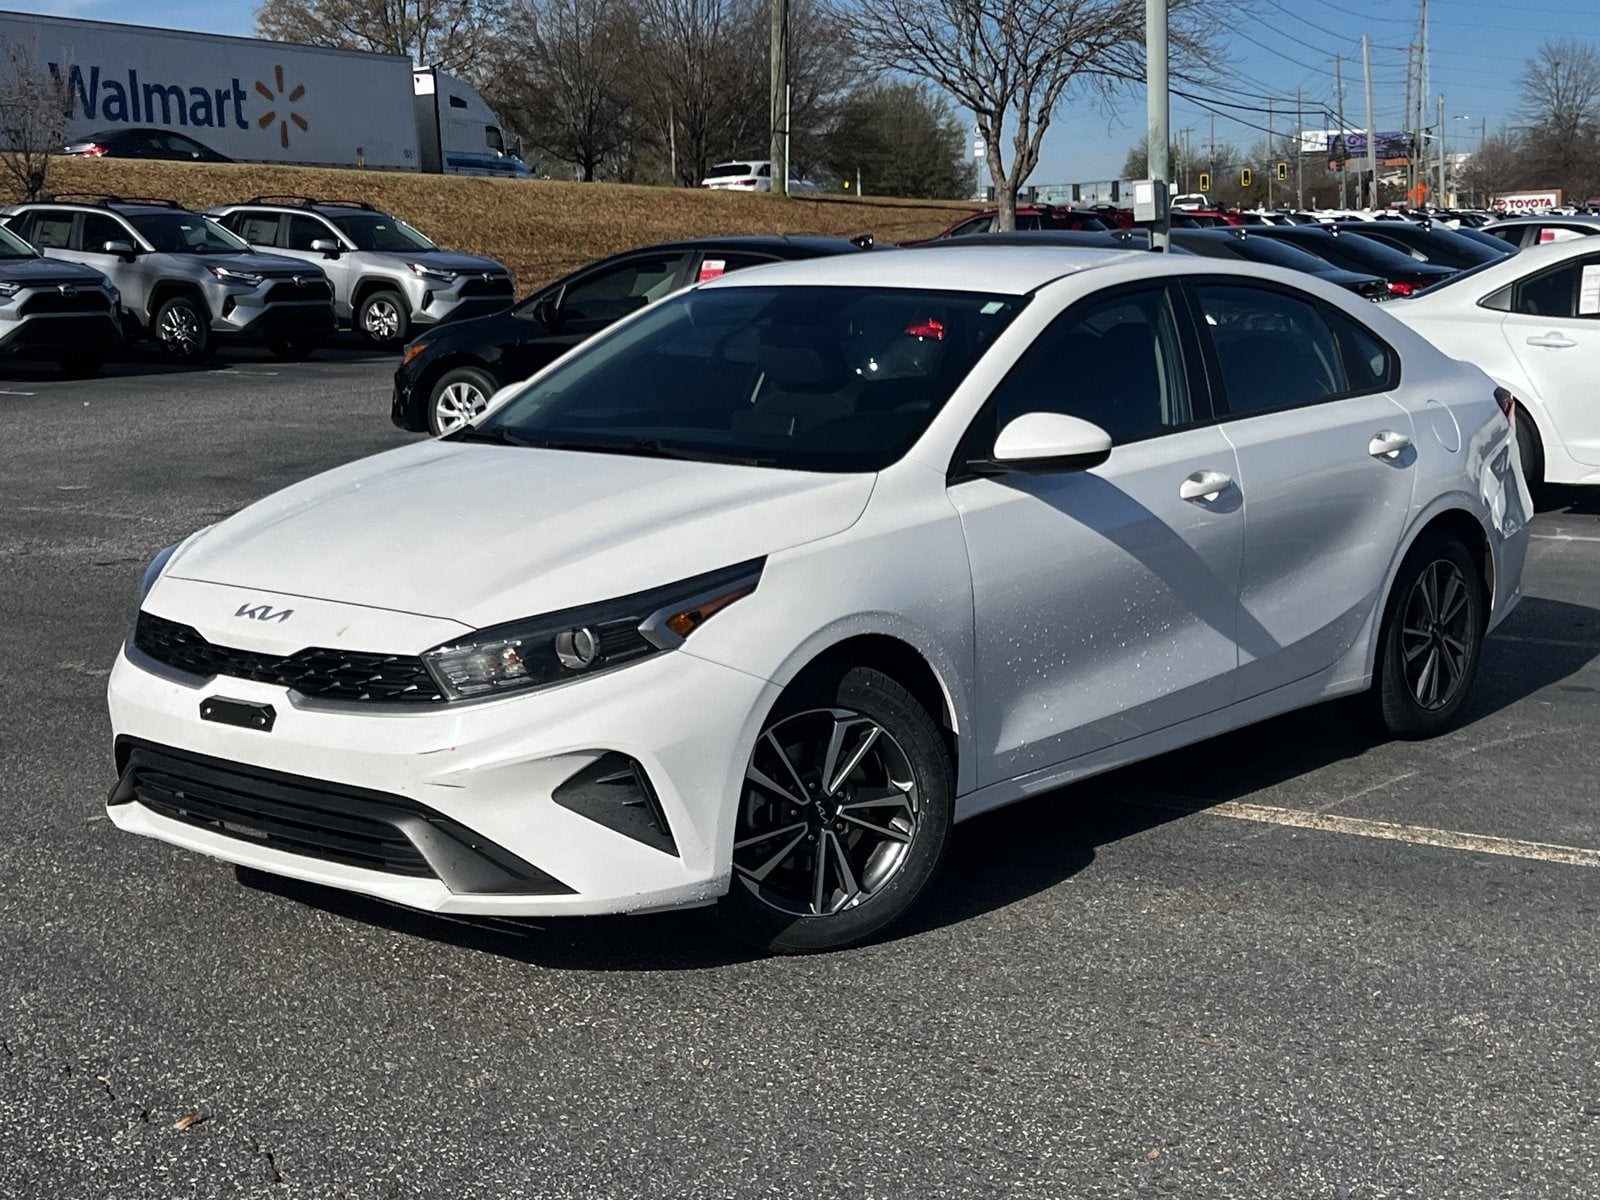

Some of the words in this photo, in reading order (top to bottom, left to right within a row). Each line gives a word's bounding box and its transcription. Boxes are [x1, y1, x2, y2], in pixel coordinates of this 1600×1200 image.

[48, 62, 248, 130] Walmart
[1509, 198, 1552, 209] TOYOTA
[234, 603, 294, 623] KIA
